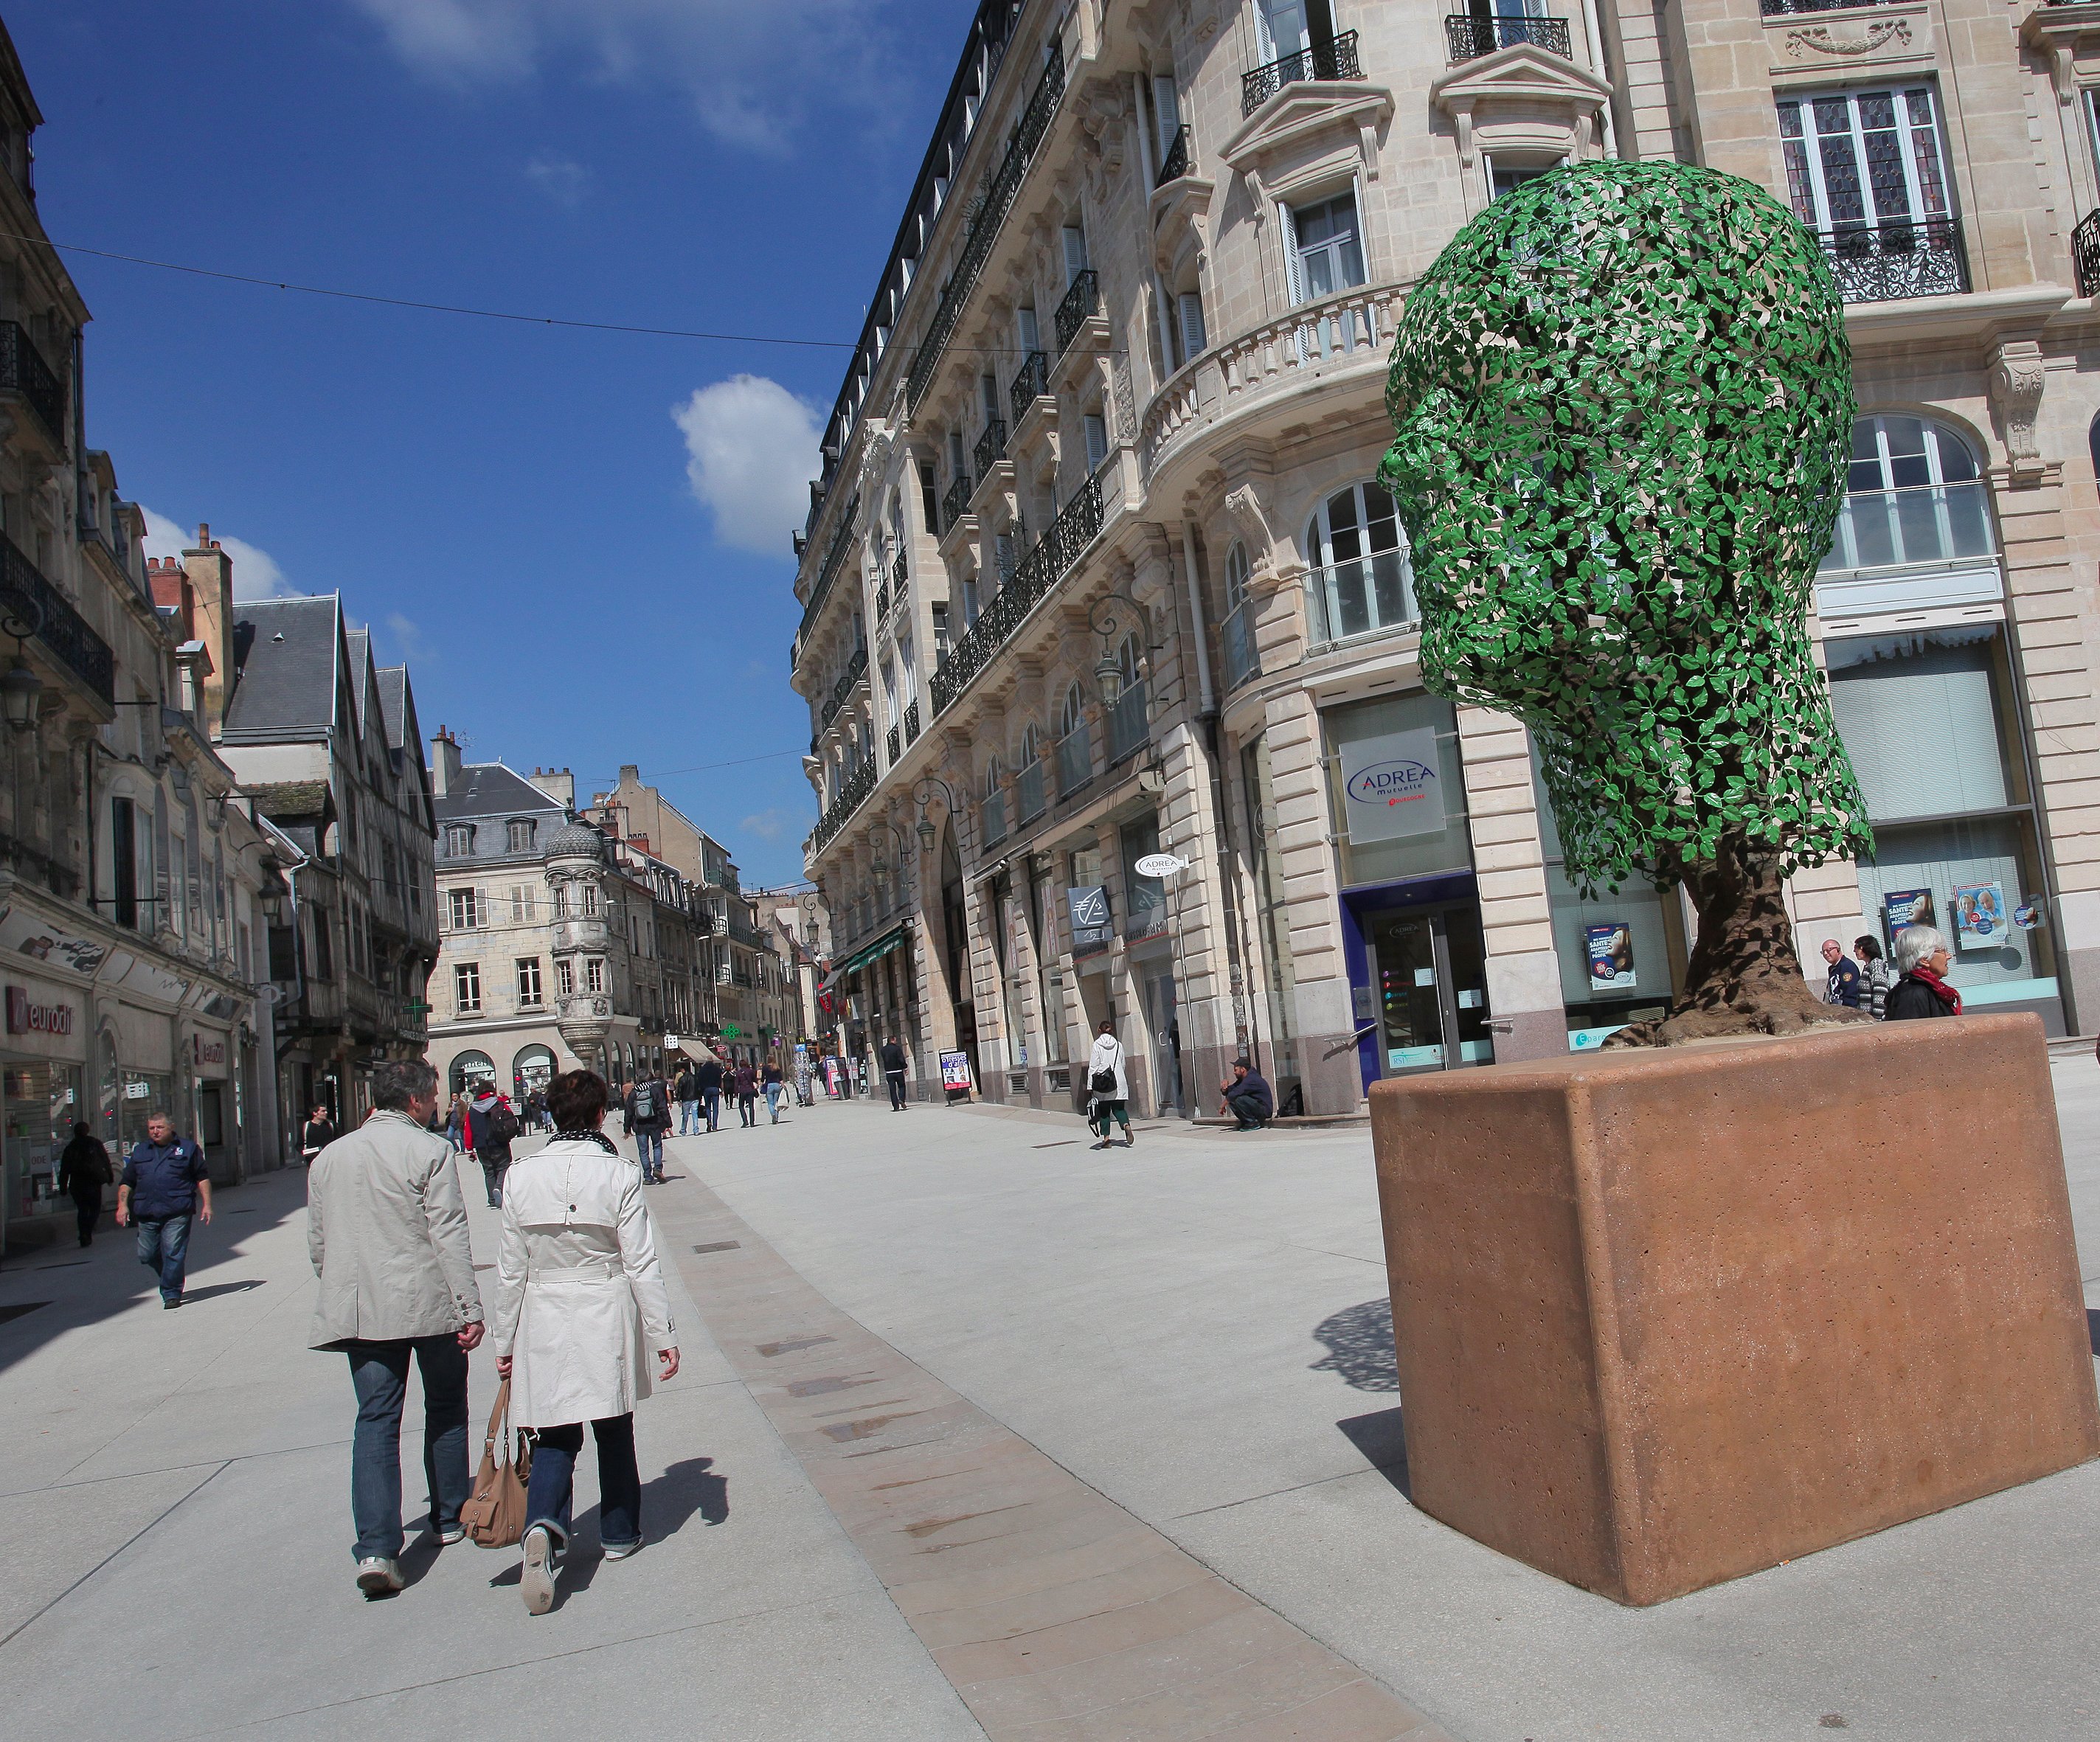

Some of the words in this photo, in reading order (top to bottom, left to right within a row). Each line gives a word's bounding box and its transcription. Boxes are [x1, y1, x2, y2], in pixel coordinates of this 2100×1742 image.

[1362, 766, 1435, 790] ADREA
[1377, 783, 1422, 795] mutuelle
[1389, 794, 1425, 806] BOURGOGNE
[1395, 925, 1418, 934] ADREA
